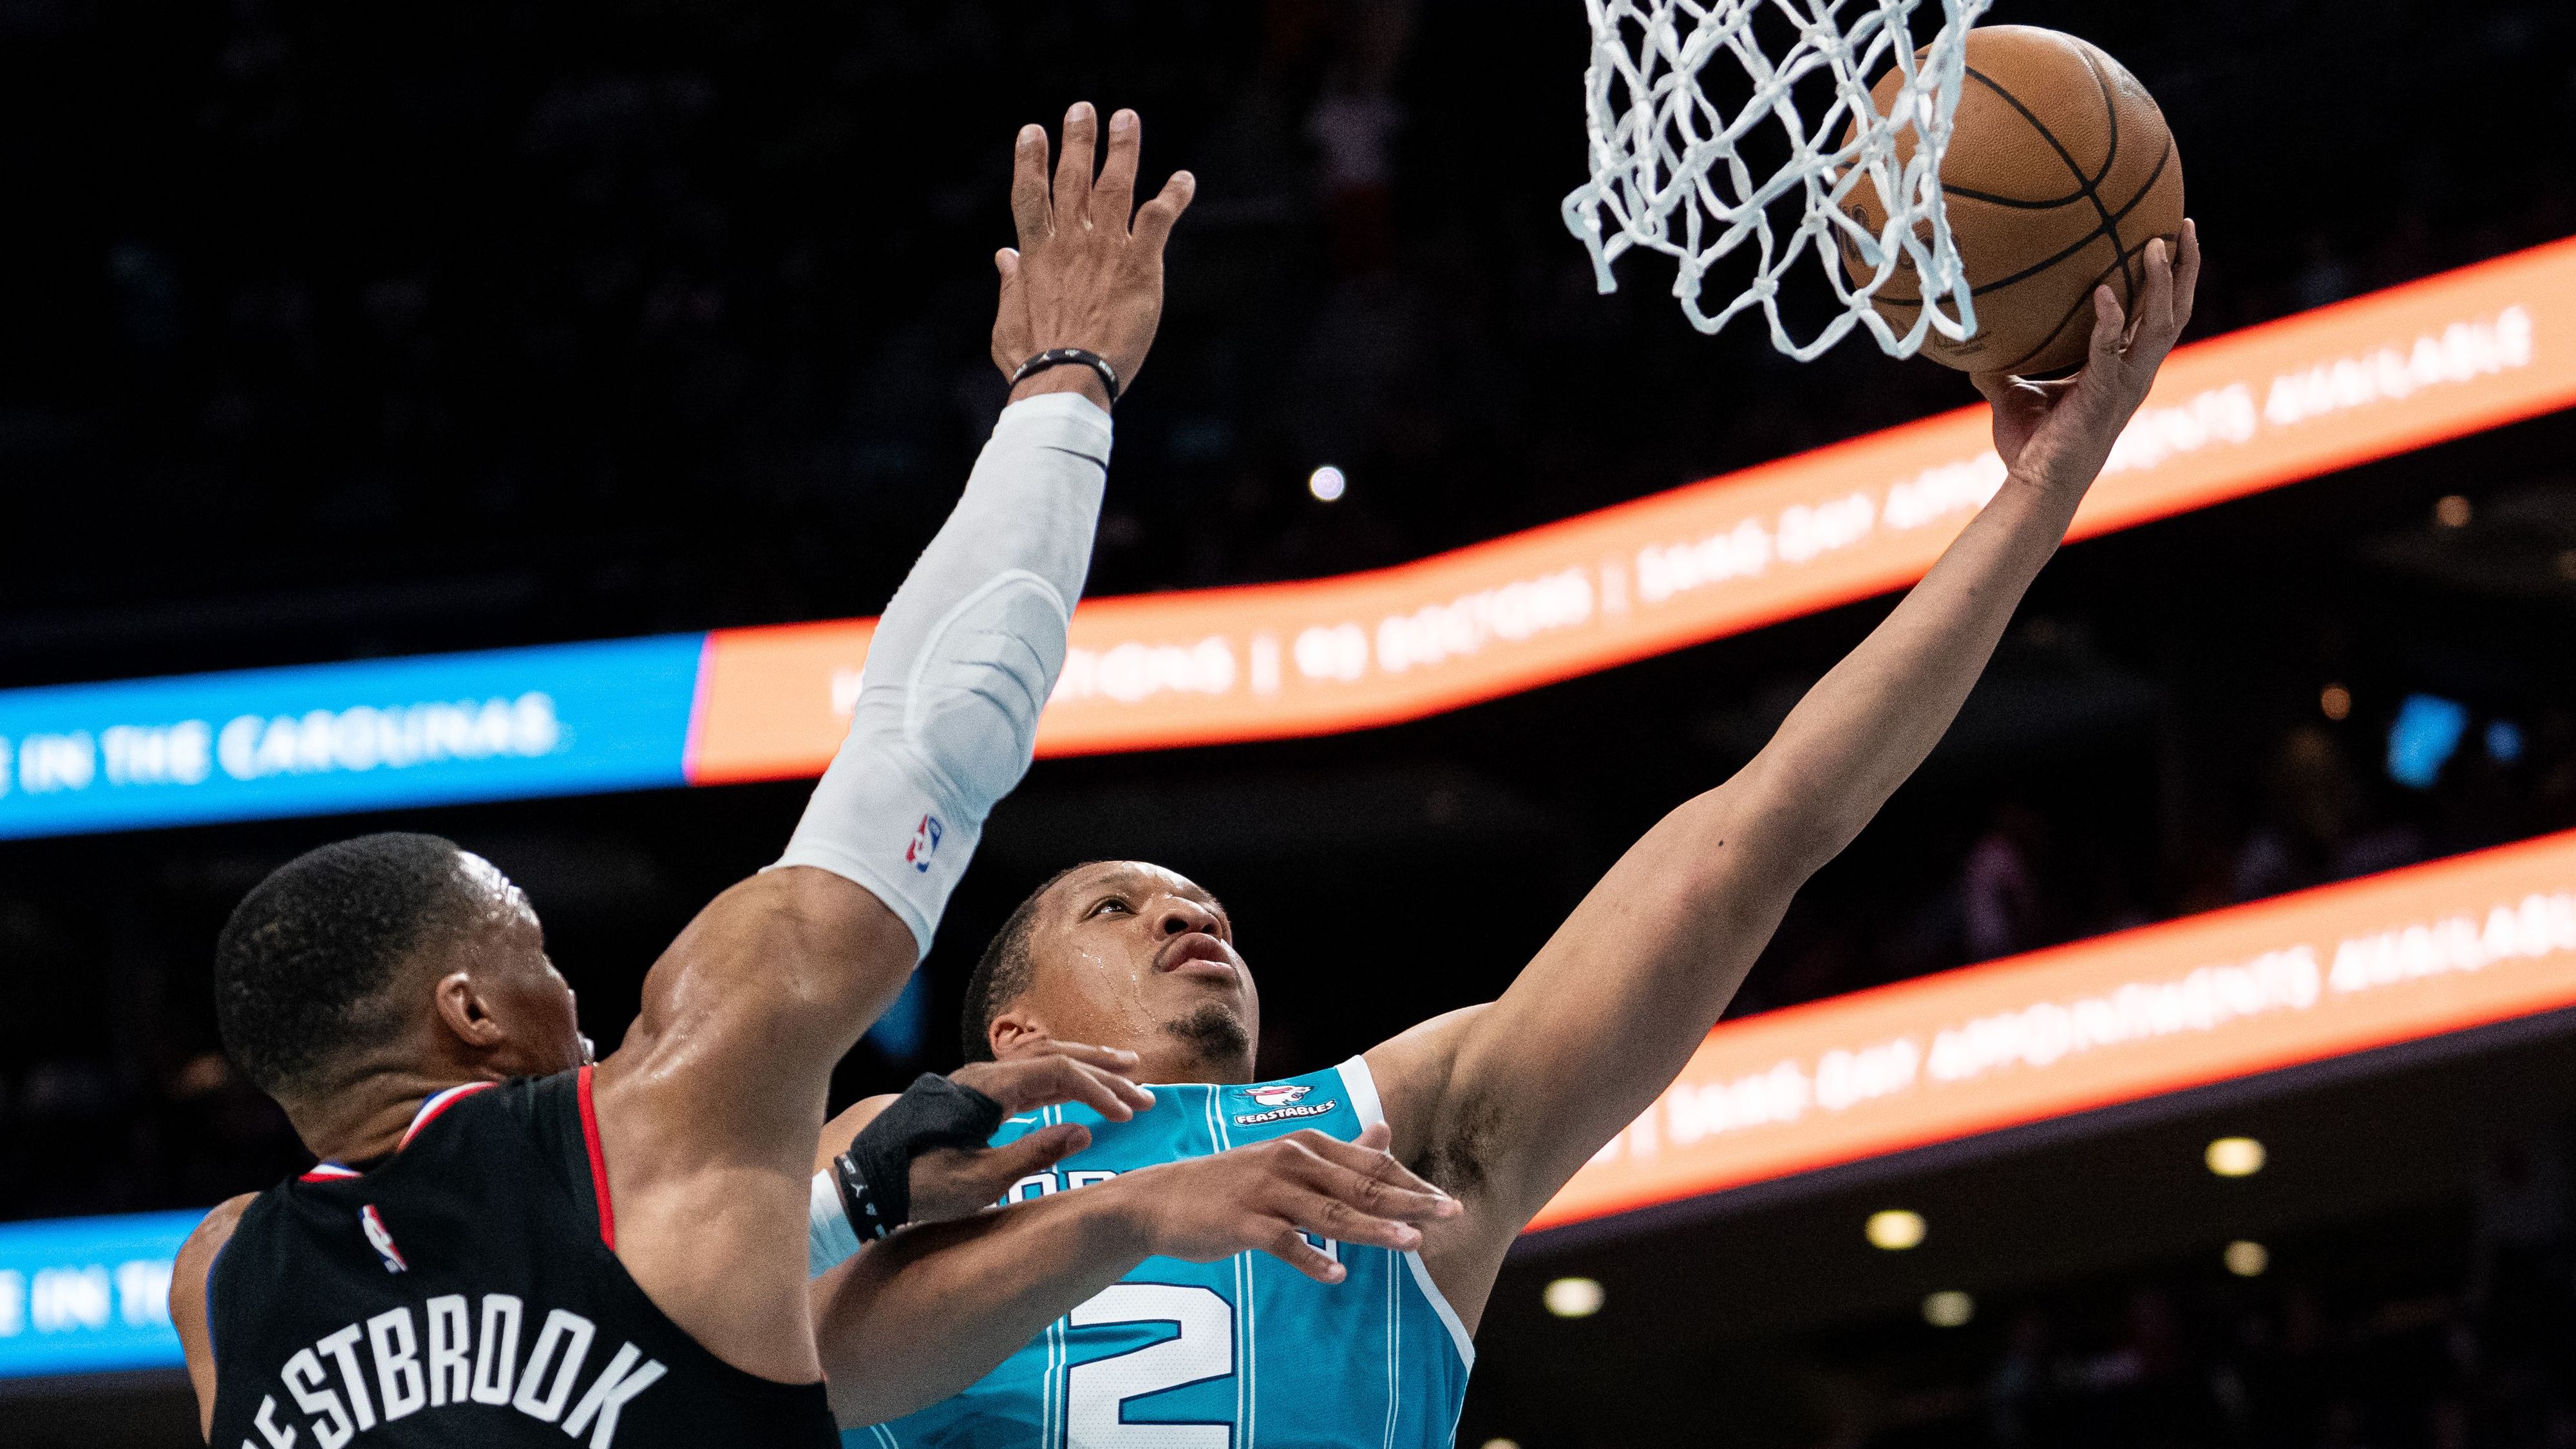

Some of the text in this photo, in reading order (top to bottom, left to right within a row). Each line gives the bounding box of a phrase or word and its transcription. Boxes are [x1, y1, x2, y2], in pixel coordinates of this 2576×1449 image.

[100, 720, 211, 785] THE
[1235, 1099, 1337, 1125] FEASTABLES
[241, 1293, 668, 1449] ESTBROOK
[1066, 1281, 1236, 1449] 2
